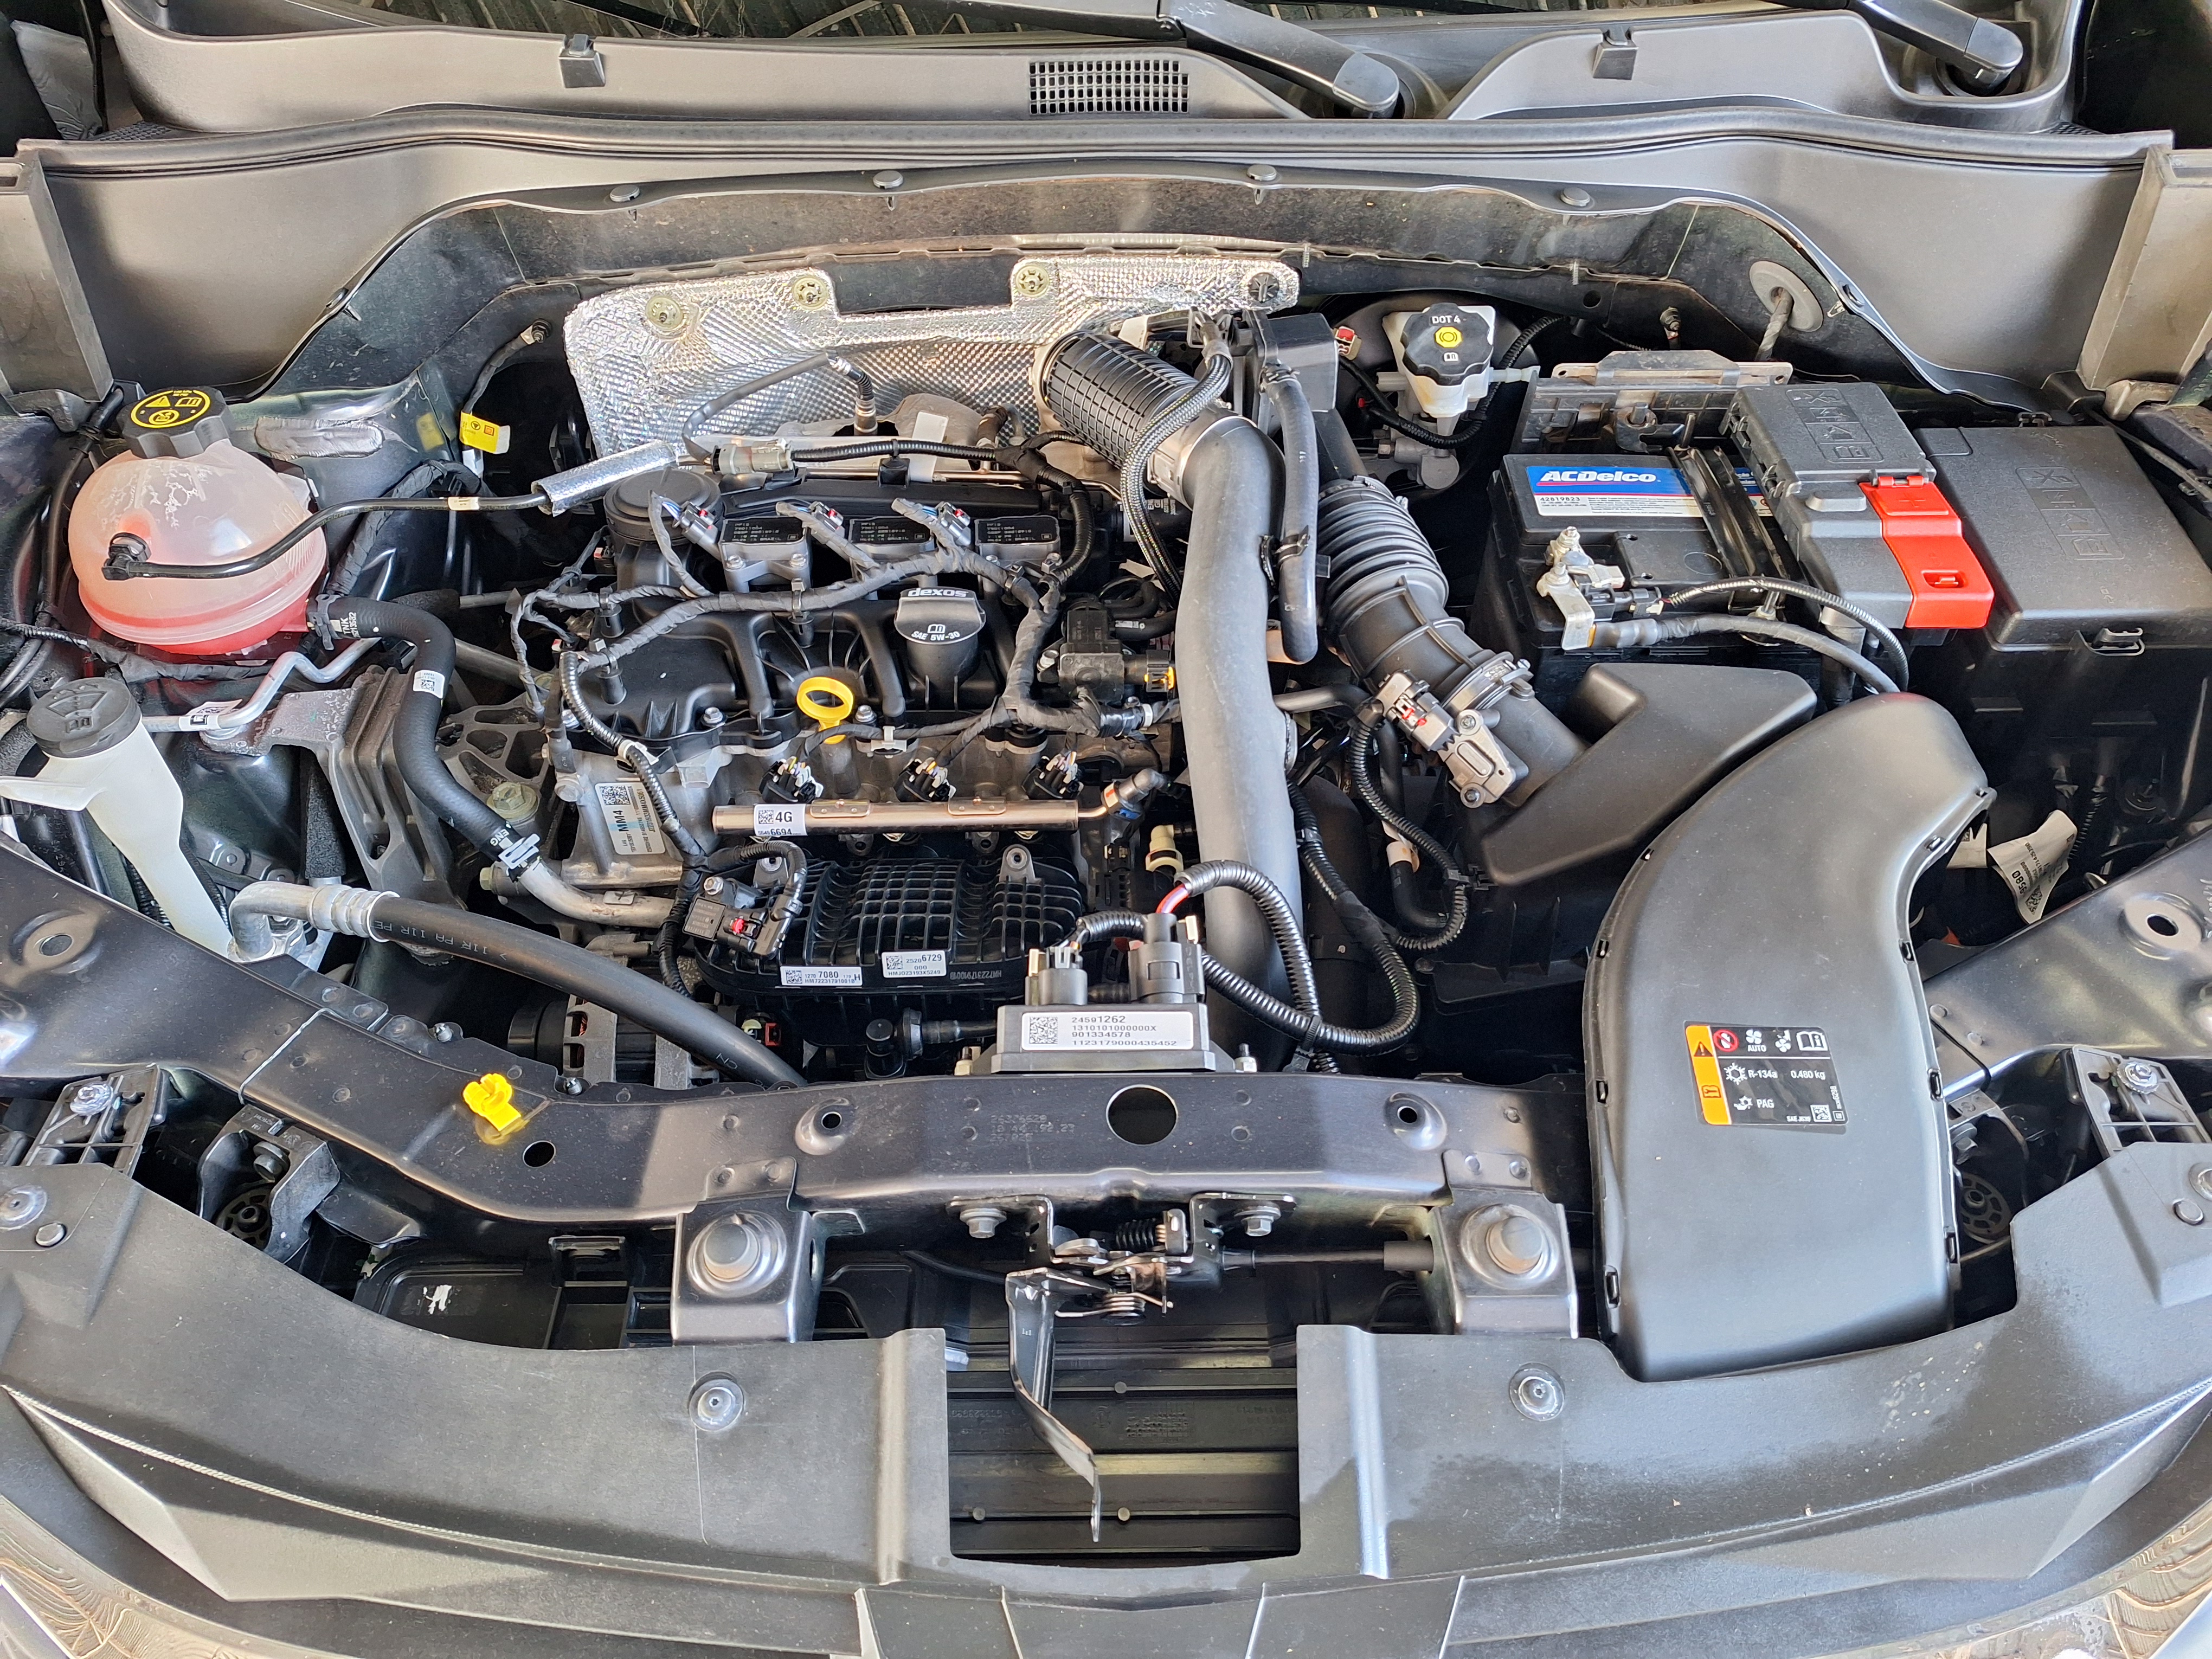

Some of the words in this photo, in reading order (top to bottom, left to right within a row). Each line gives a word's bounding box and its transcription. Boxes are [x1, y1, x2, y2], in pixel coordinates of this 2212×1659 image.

[1432, 316, 1452, 324] DOT
[1454, 315, 1461, 324] 4
[1540, 471, 1656, 482] ACDelco
[908, 588, 969, 597] dexos
[340, 617, 351, 635] TNK
[911, 631, 929, 640] SAE
[930, 631, 960, 641] 5W-30
[612, 809, 629, 832] MM4
[775, 811, 793, 822] 4G
[435, 933, 454, 946] PA
[906, 954, 942, 963] 25206729
[1747, 1070, 1778, 1078] R-134a
[1791, 1070, 1814, 1079] 0.480
[1815, 1070, 1826, 1080] kg
[1757, 1099, 1774, 1108] PAG
